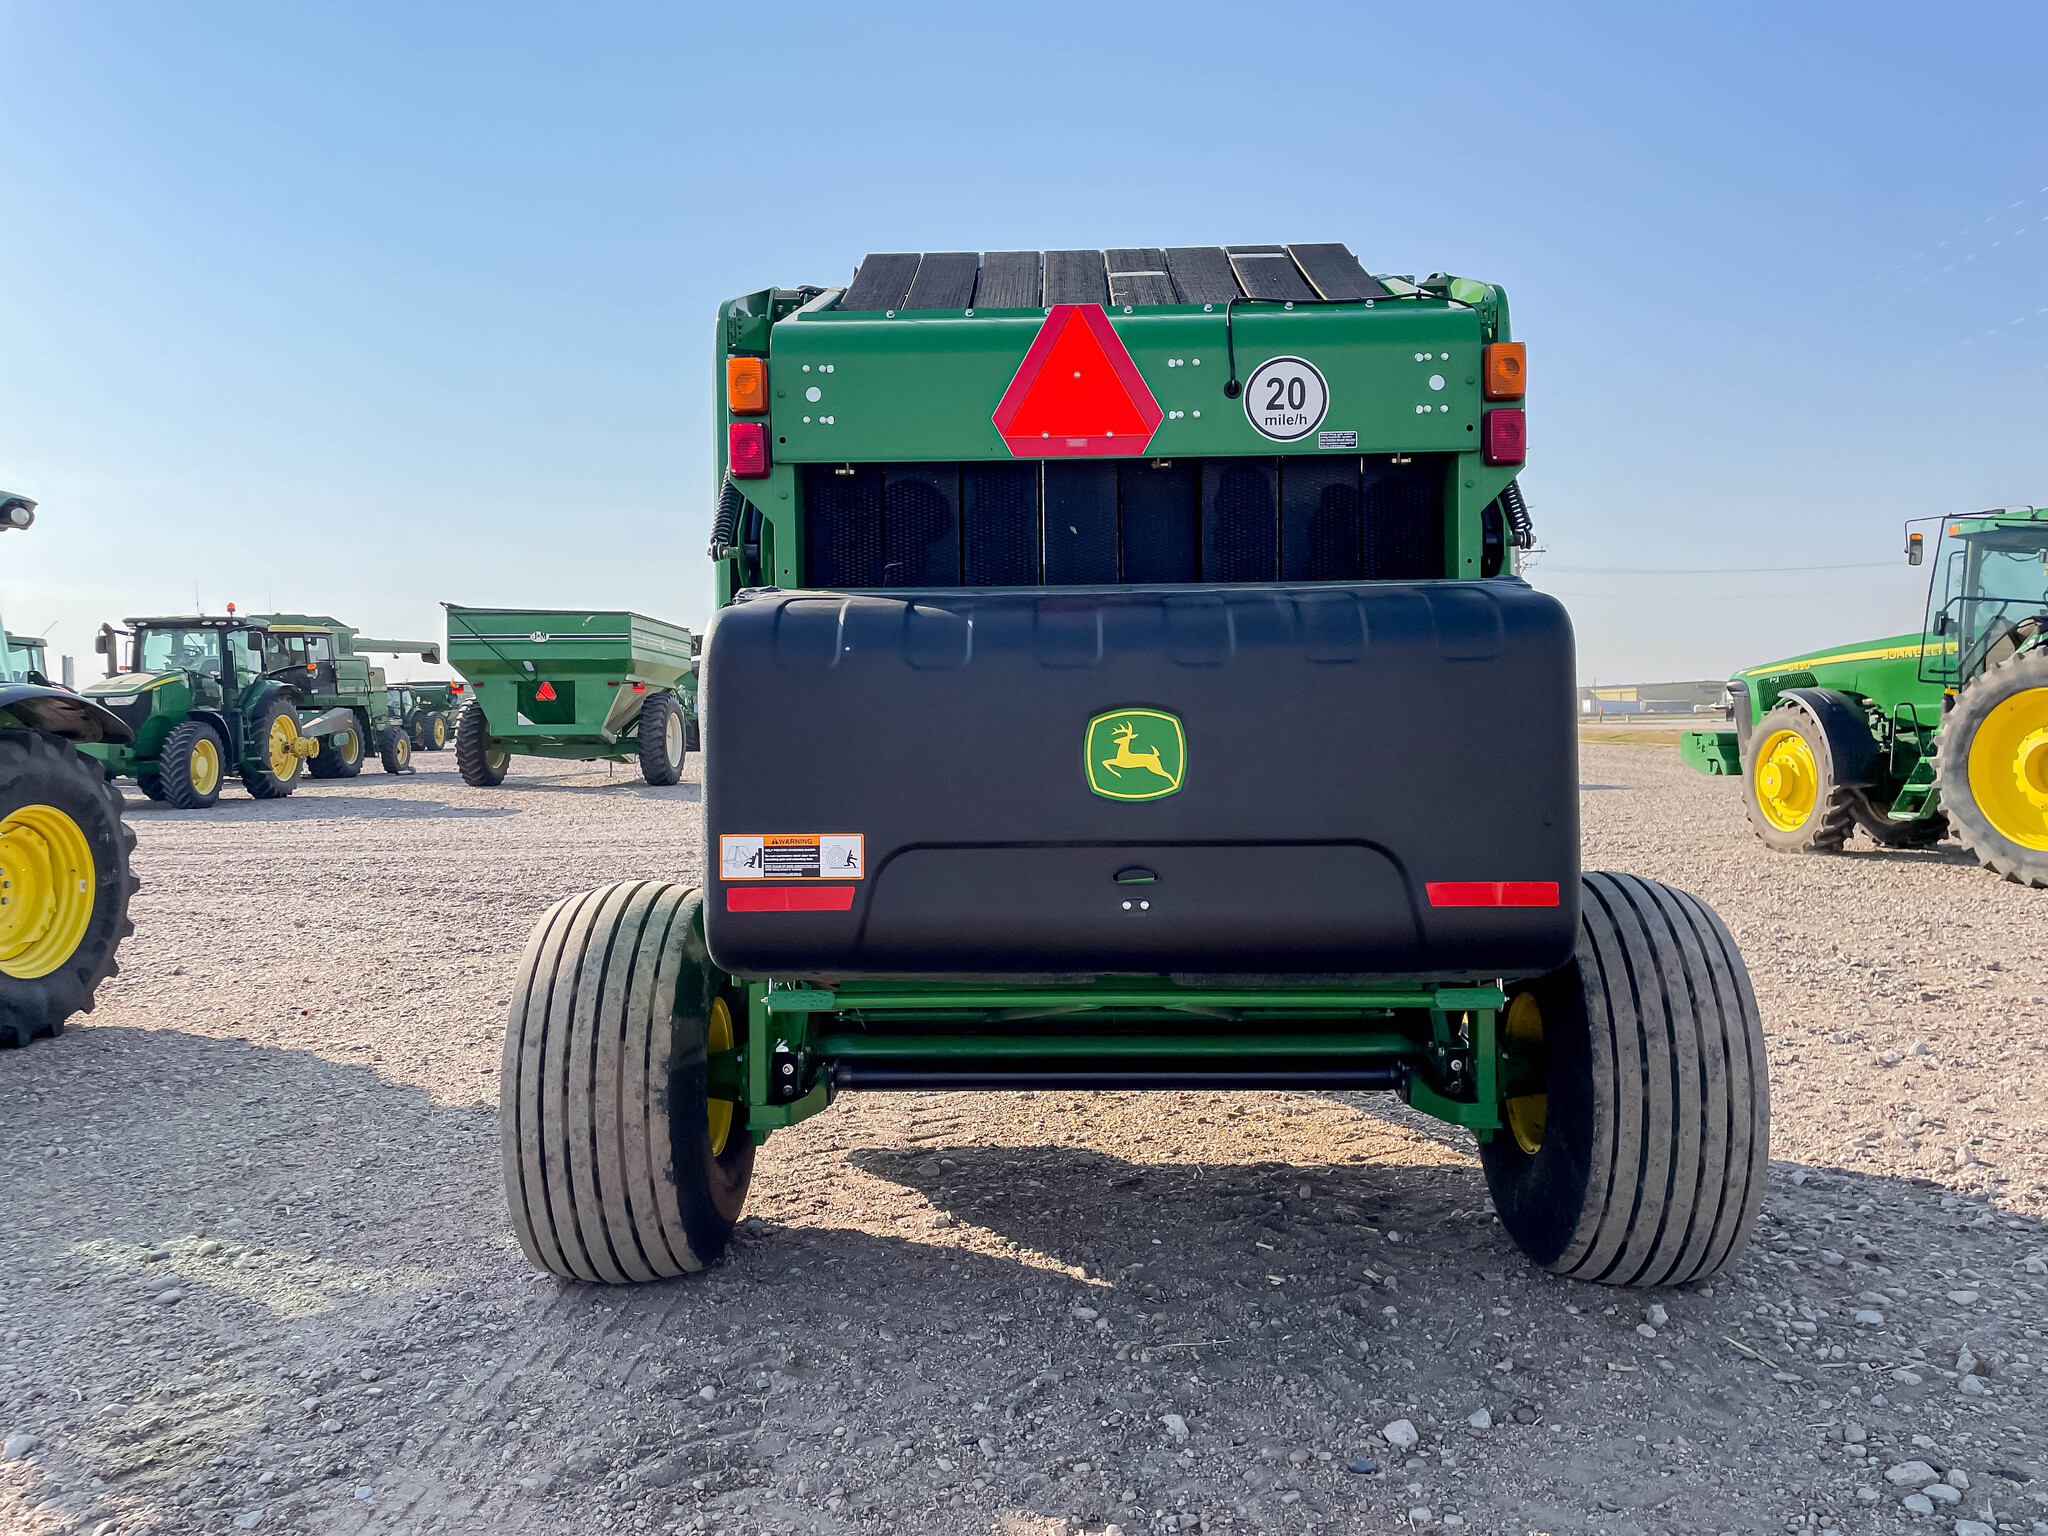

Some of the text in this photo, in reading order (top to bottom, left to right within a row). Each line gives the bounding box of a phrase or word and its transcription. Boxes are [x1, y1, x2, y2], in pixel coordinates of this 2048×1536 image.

[1266, 377, 1306, 411] 20
[1265, 413, 1308, 426] mile/h
[1882, 649, 1913, 661] JOHN
